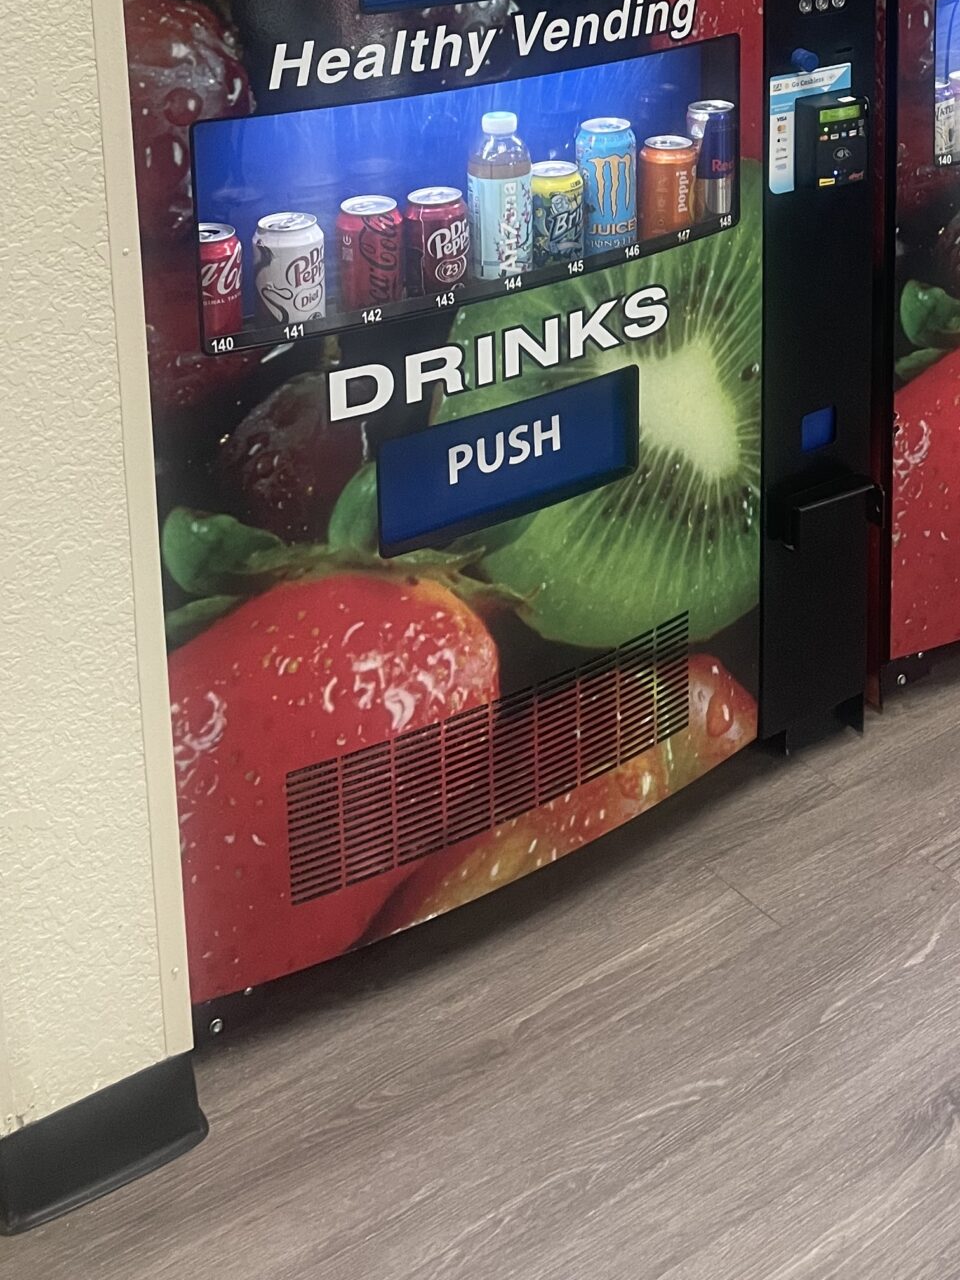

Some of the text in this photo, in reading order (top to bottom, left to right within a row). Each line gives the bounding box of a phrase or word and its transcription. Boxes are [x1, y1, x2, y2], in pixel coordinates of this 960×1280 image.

[268, 26, 497, 92] Healthy
[938, 154, 952, 166] 140
[675, 170, 689, 213] poppi
[450, 219, 467, 242] Dr
[588, 219, 637, 236] JUICE
[677, 228, 692, 243] 147
[310, 245, 324, 267] Dr
[625, 243, 641, 259] 146
[446, 265, 459, 276] 23
[567, 259, 584, 275] 145
[504, 276, 522, 291] 144
[300, 290, 320, 309] Diet
[435, 291, 456, 308] 143
[362, 307, 383, 325] 142
[283, 322, 305, 340] 141
[211, 336, 235, 354] 140
[329, 285, 669, 422] DRINKS
[448, 414, 561, 486] PUSH
